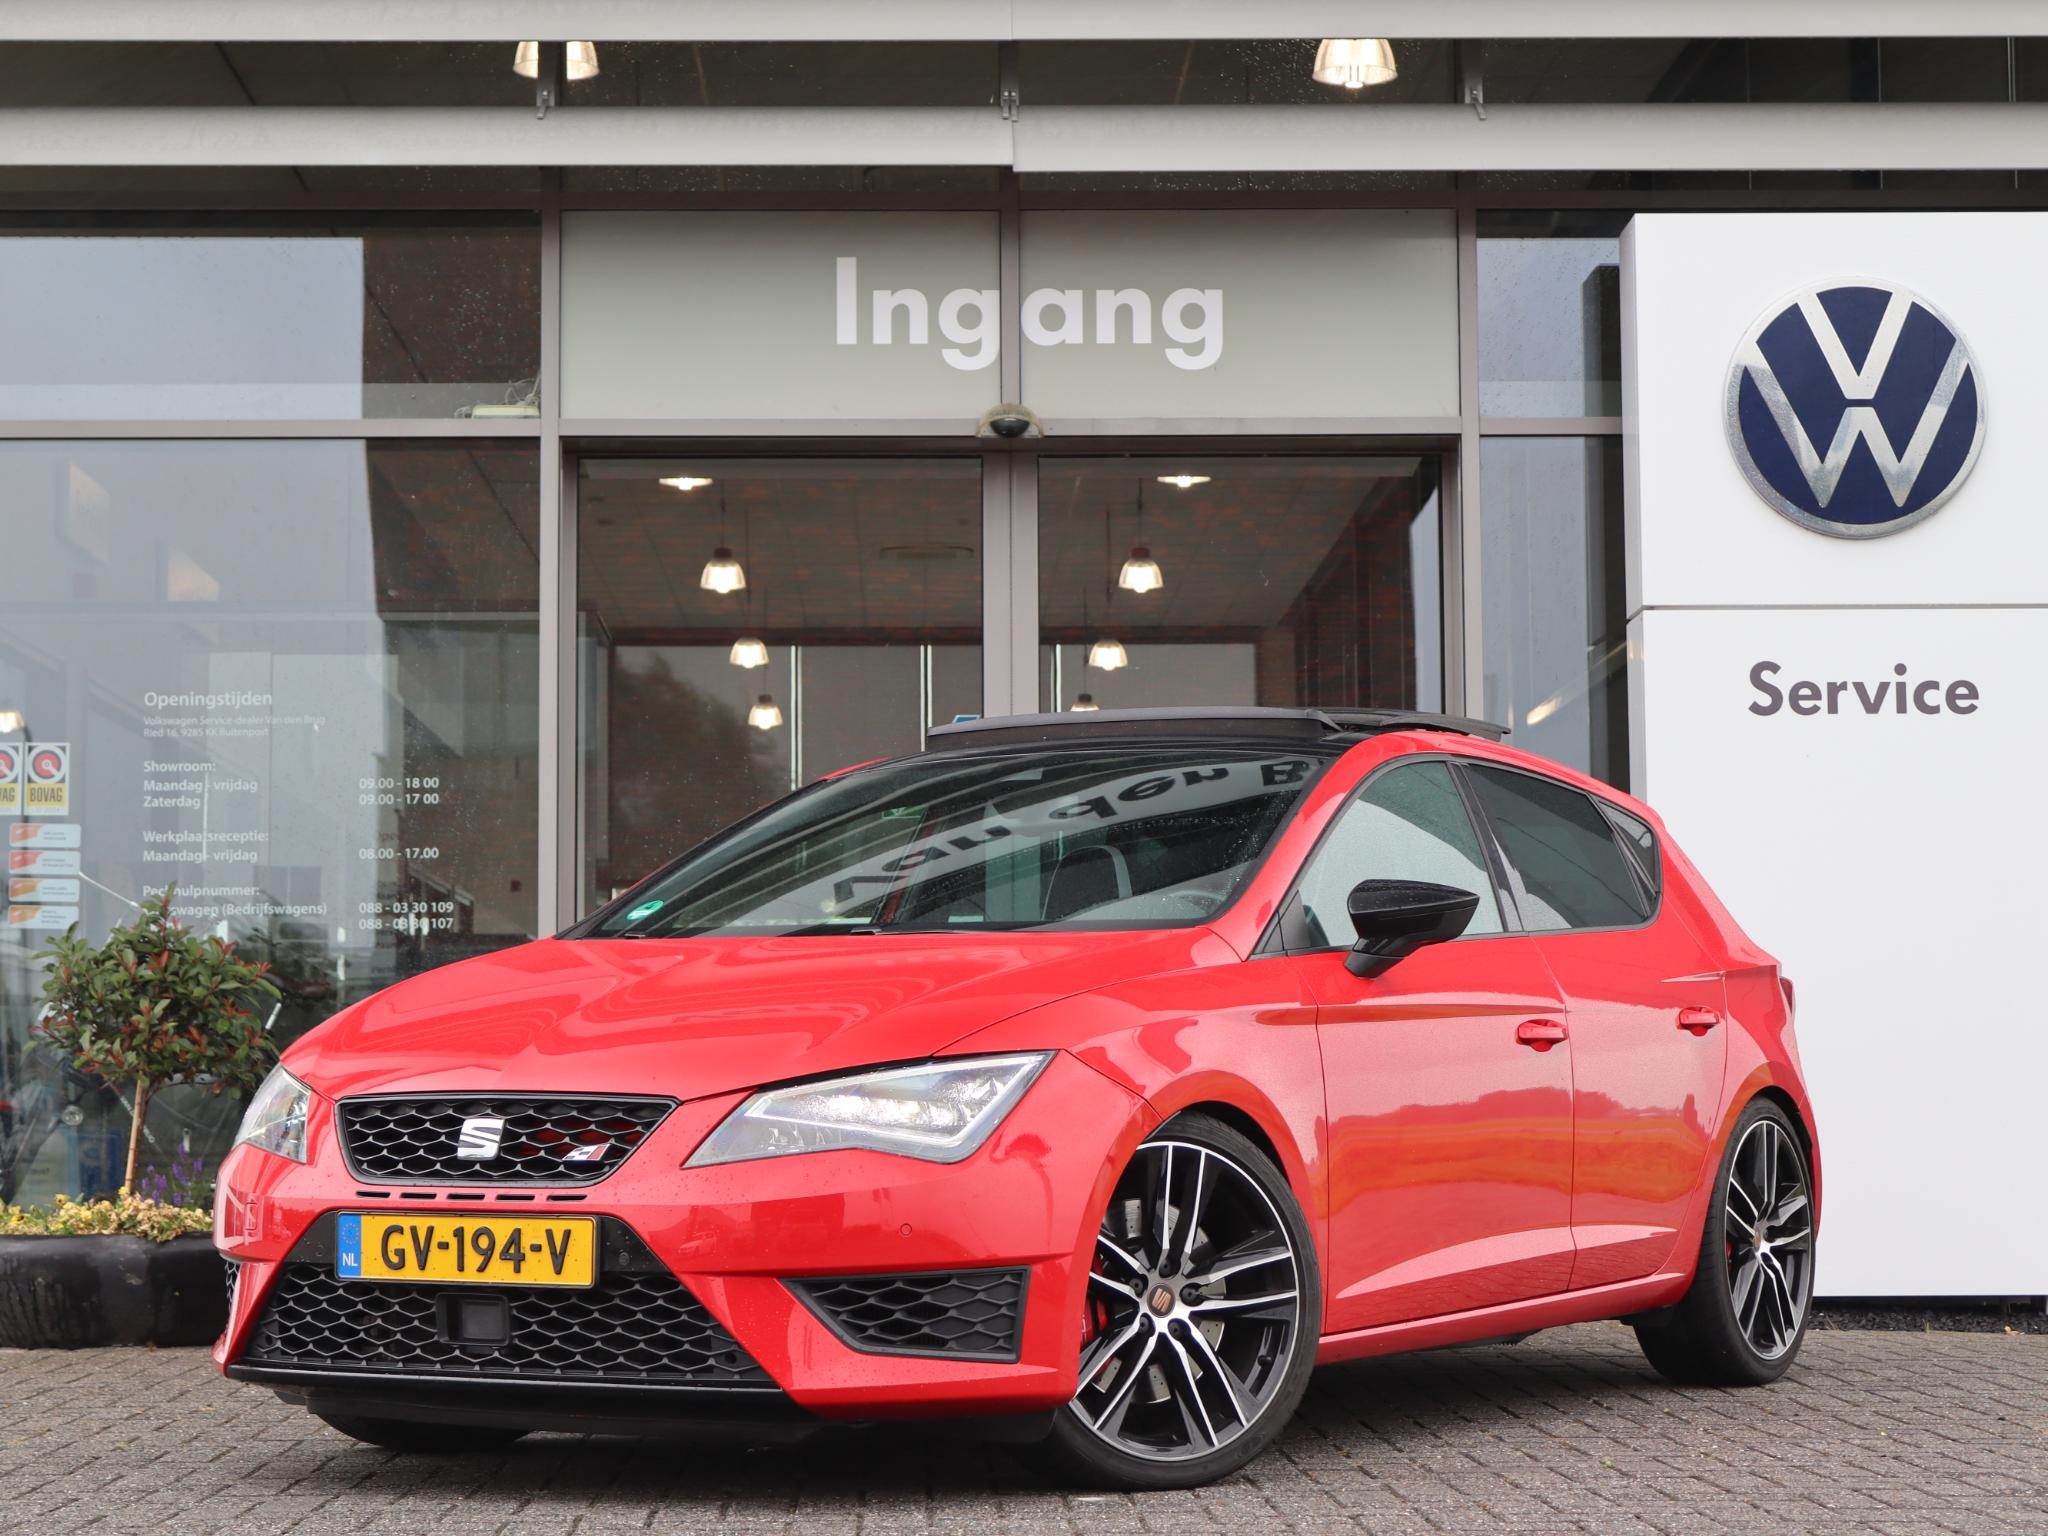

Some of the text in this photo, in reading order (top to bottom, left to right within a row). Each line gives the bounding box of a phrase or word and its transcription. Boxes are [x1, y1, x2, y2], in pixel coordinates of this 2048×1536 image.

[836, 256, 1224, 371] Ingang
[1747, 660, 1980, 717] Service
[144, 691, 273, 710] Openingstijden
[143, 760, 217, 773] Showroom:
[143, 779, 204, 794] Maandag
[213, 778, 259, 794] vrijdag
[359, 777, 394, 789] 09.00
[30, 786, 63, 803] BOVAG
[143, 795, 201, 810] Zaterdag
[359, 793, 394, 805] 09.00
[142, 849, 203, 864] Maandag
[213, 848, 258, 864] vrijdag
[358, 848, 394, 860] 08.00
[405, 847, 440, 860] 17.00
[222, 902, 328, 919] (Bedrijfswagens)
[358, 902, 383, 914] 088
[392, 902, 408, 914] 03
[411, 902, 428, 914] 30
[431, 901, 455, 914] 109
[358, 917, 383, 930] 088
[431, 917, 454, 930] 107
[380, 1223, 572, 1276] GV-194-V
[342, 1252, 359, 1267] NL
